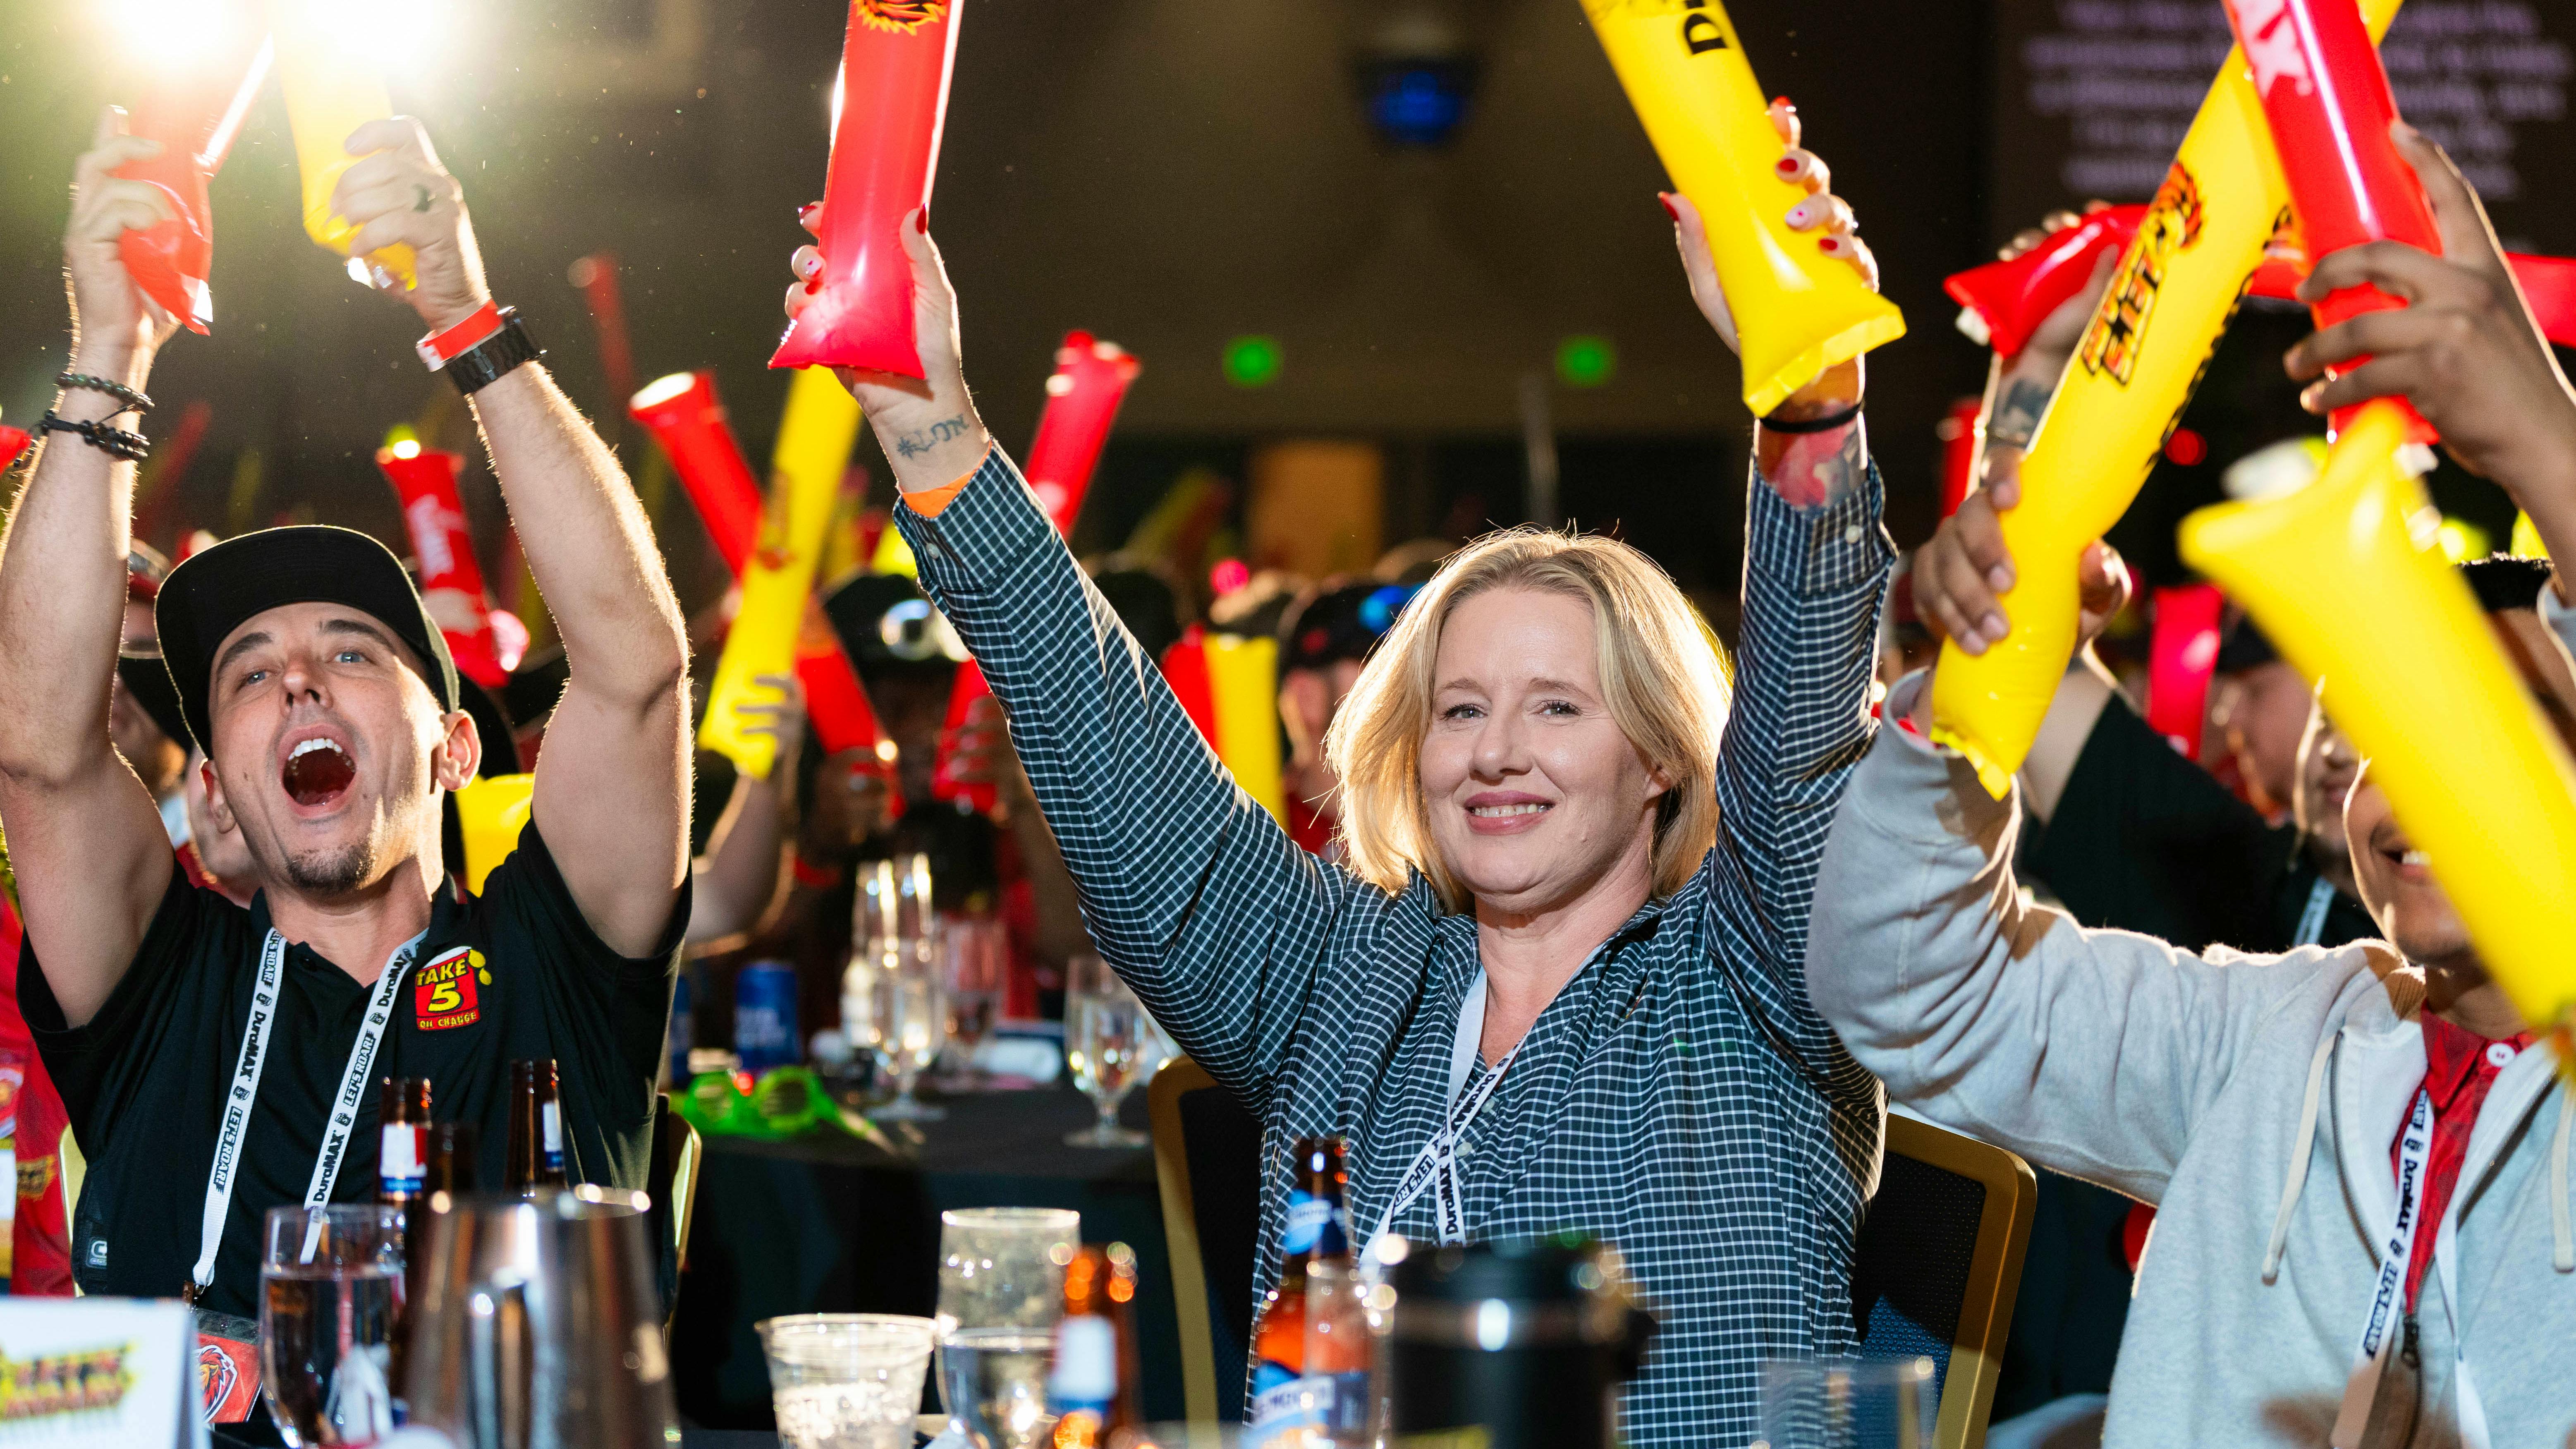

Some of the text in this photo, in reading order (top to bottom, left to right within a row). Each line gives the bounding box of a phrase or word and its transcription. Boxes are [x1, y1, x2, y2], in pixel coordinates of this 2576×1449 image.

[269, 931, 284, 951] ET'S
[262, 951, 277, 984] ROAR!
[416, 958, 467, 986] TAKE
[428, 980, 461, 1012] 5
[419, 1012, 476, 1028] OIL CHANGE
[240, 1011, 266, 1080] DuraMAX
[343, 1072, 363, 1107] LET'S
[355, 1035, 376, 1073] ROAR!
[225, 1106, 243, 1145] LET'S
[214, 1143, 234, 1187] ROAR!
[313, 1132, 345, 1201] DuraMAX
[1408, 1154, 1435, 1193] LET'S
[1440, 1162, 1459, 1235] DuraMAX
[2397, 1159, 2418, 1234] DuraMAX
